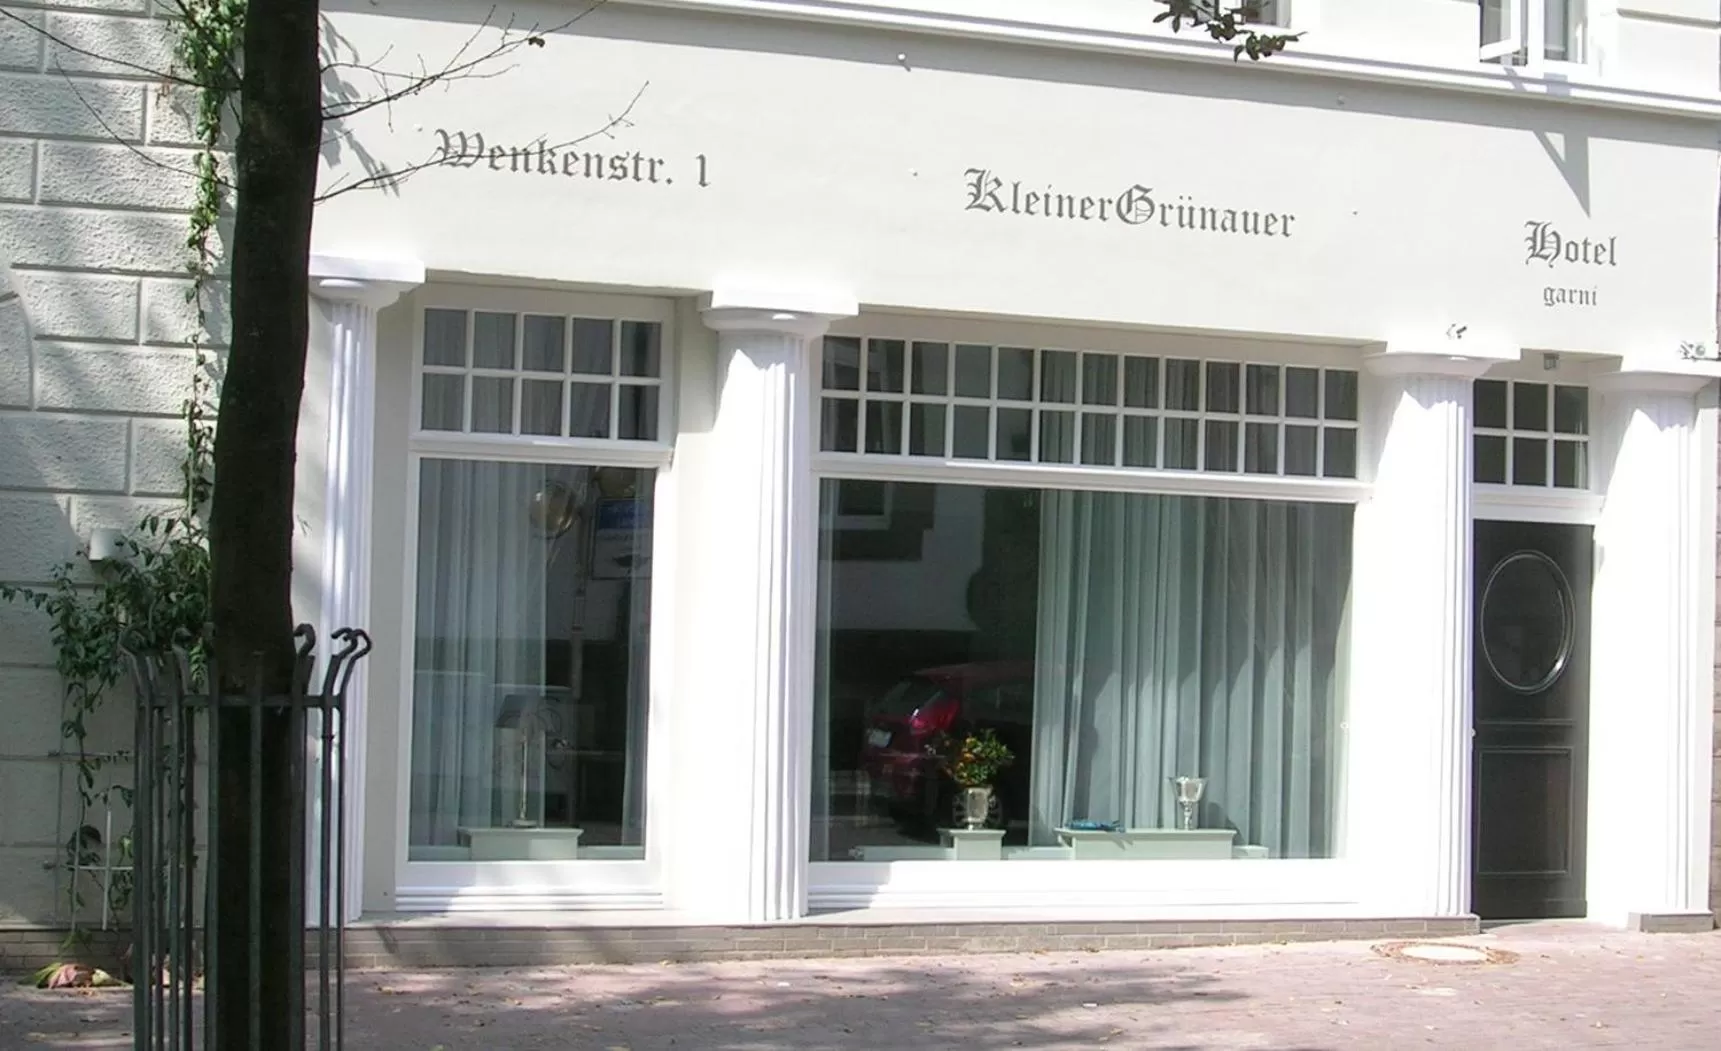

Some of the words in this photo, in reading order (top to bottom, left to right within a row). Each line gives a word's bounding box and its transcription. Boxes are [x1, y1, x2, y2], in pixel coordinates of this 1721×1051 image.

[434, 128, 673, 185] Wenkenstr.
[696, 154, 709, 187] 1
[1524, 221, 1617, 268] Hotel
[1543, 286, 1598, 306] garni
